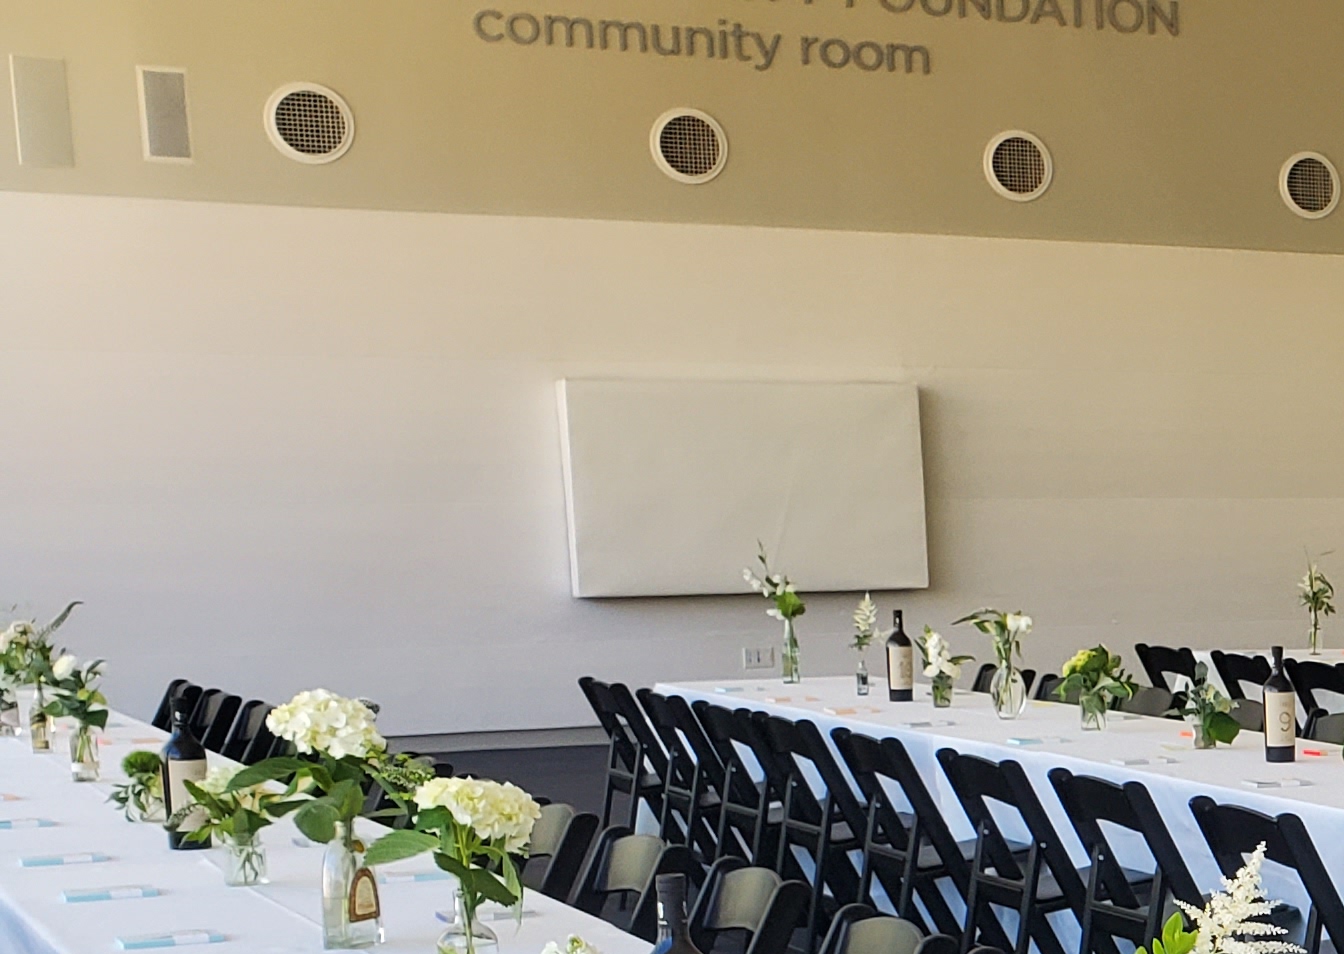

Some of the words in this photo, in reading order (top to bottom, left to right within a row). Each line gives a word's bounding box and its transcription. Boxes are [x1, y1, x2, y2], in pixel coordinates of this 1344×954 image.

[846, 0, 1180, 37] UNDATION
[473, 9, 782, 71] community
[801, 36, 932, 74] room
[1279, 711, 1291, 733] 9
